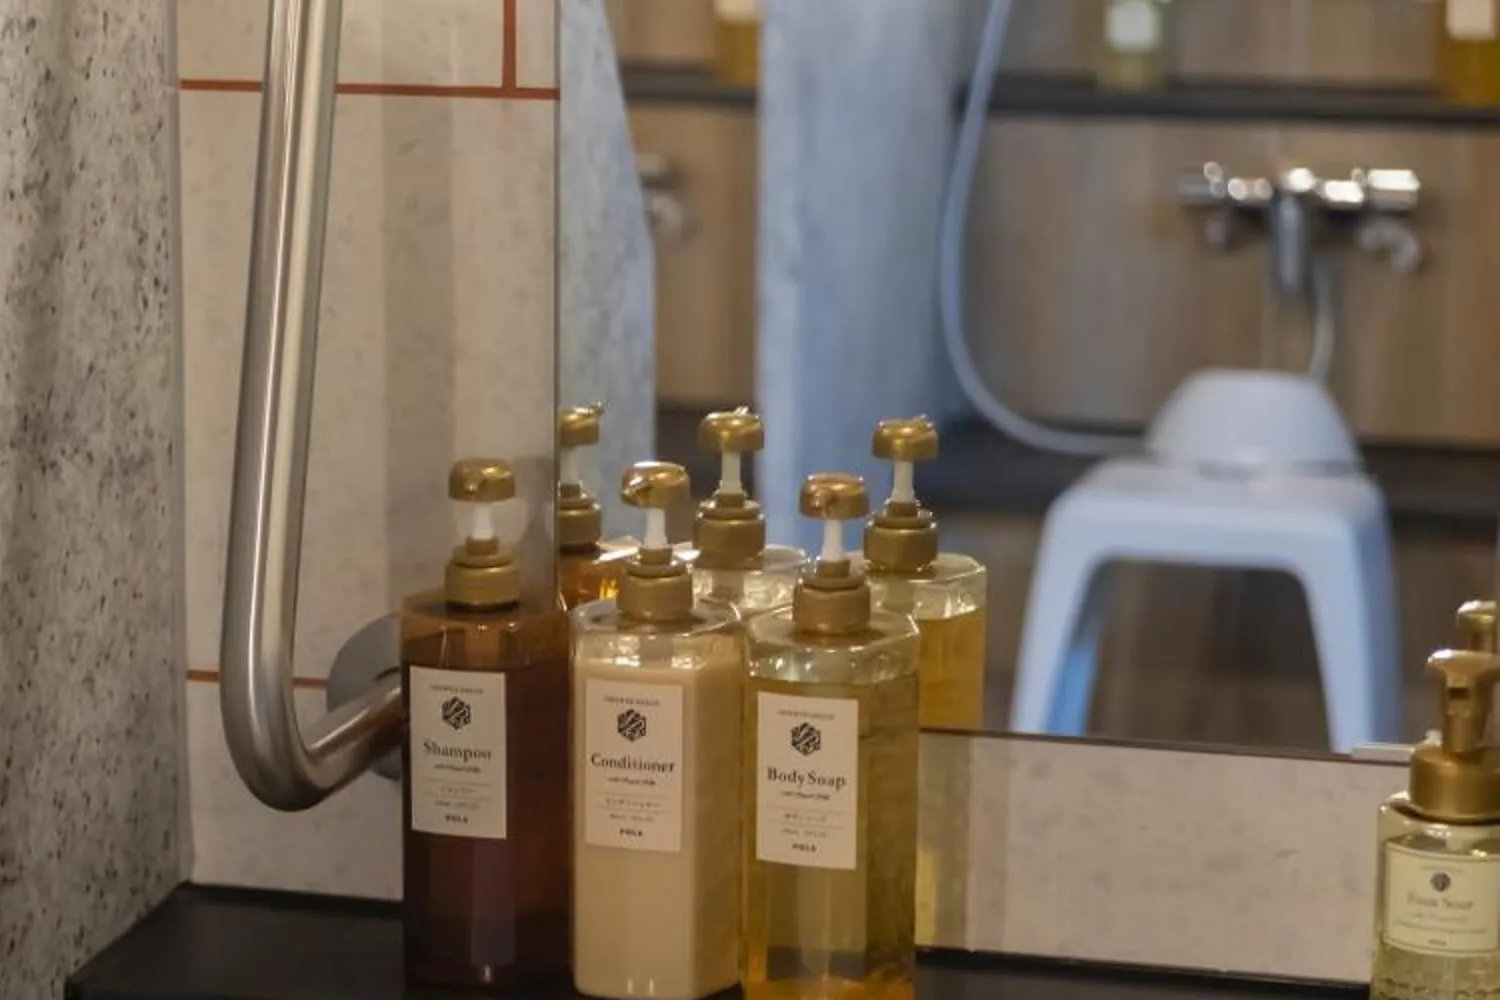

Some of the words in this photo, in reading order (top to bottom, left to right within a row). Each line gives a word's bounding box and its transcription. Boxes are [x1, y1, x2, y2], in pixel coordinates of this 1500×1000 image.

[422, 739, 492, 763] Shampoo
[590, 752, 676, 773] Conditioner
[766, 766, 806, 787] Body
[807, 770, 847, 792] Soap
